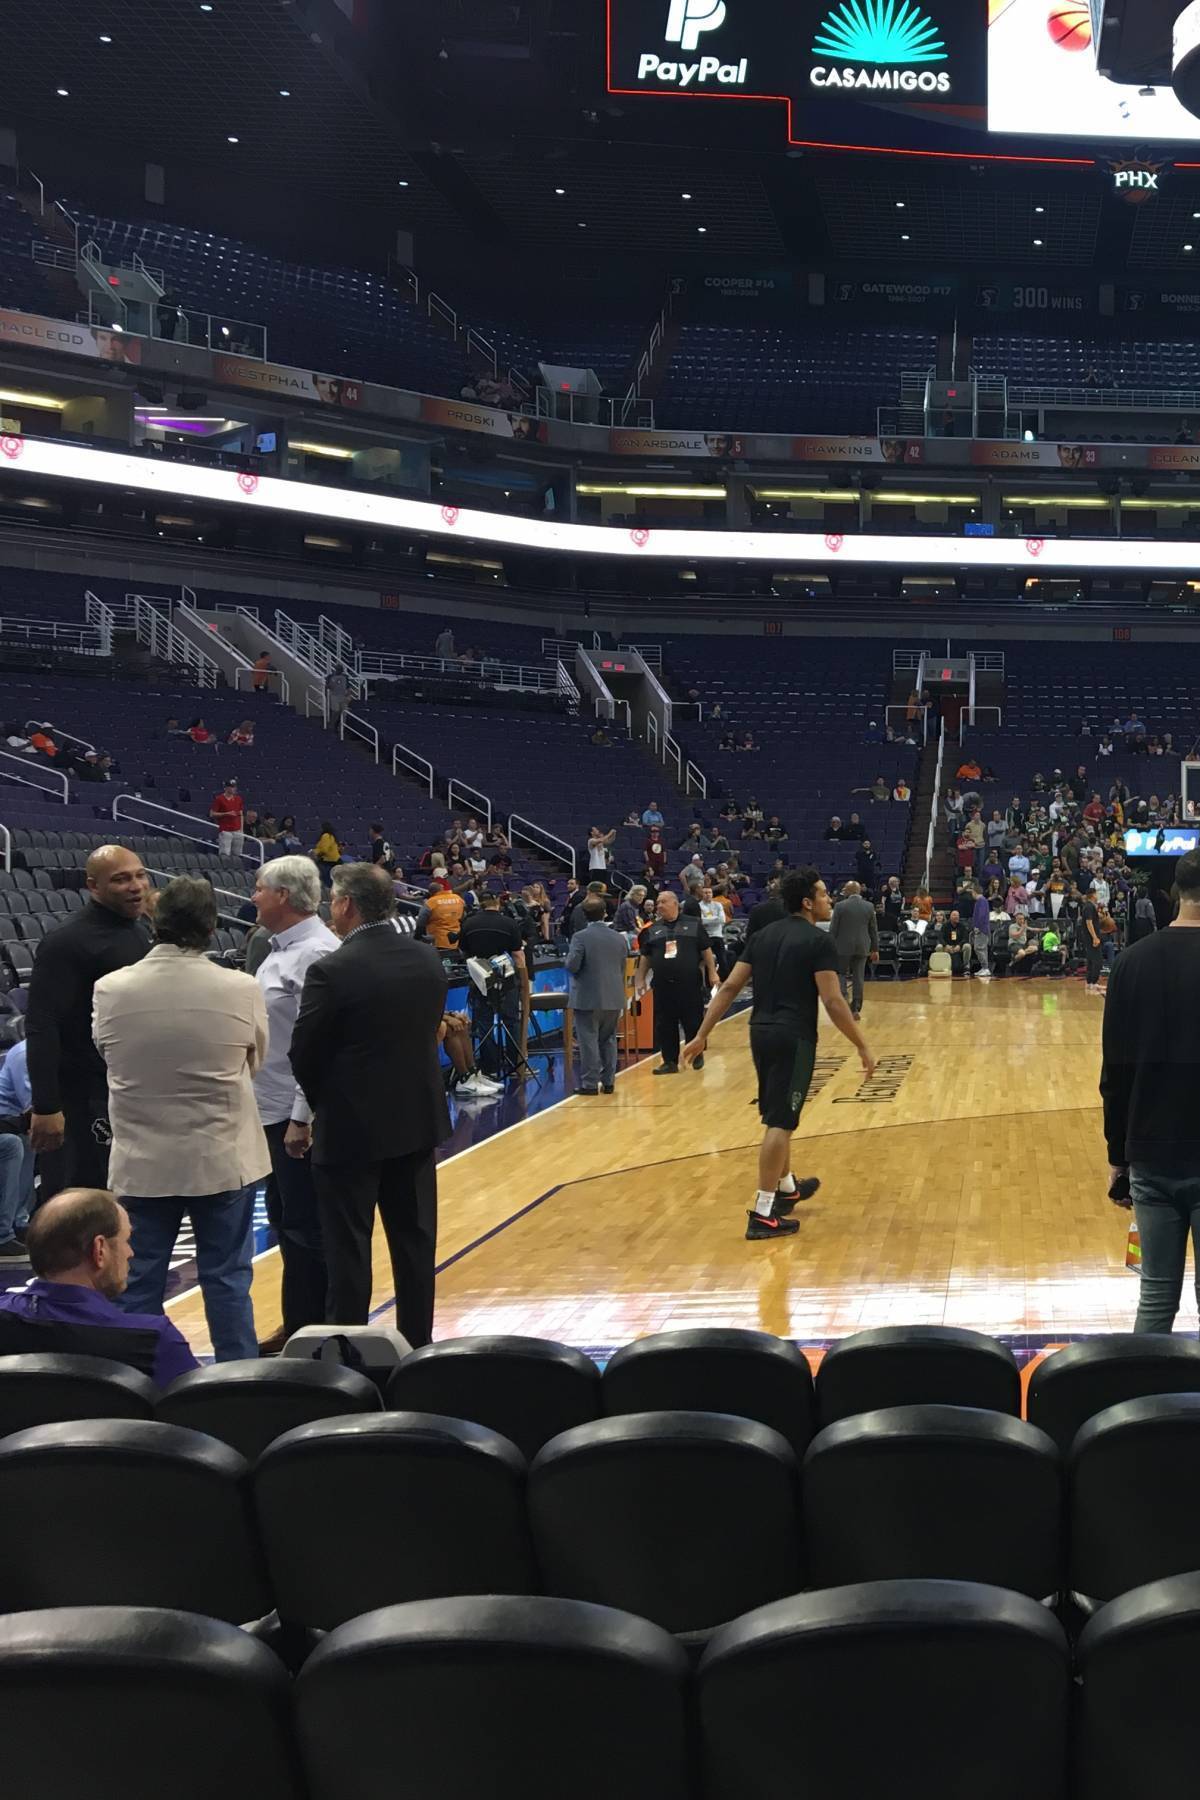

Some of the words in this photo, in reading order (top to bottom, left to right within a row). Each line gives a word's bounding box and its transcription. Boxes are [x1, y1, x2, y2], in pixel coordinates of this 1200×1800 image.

[637, 53, 748, 86] PayPal
[809, 66, 950, 91] CASAMIGOS
[1114, 169, 1160, 189] PHX
[704, 277, 754, 290] COOPER
[861, 283, 931, 297] GATEWOOD
[1012, 287, 1049, 309] 300
[1051, 297, 1084, 311] WINS
[222, 364, 310, 391] WESTPHAL
[345, 387, 358, 402] 44
[447, 409, 495, 428] PROSKI
[643, 439, 703, 451] ARSDALE
[734, 440, 742, 454] 5
[804, 445, 873, 457] HAWKINS
[908, 445, 920, 459] 42
[991, 450, 1041, 462] ADAMS
[1145, 836, 1196, 853] PyPal
